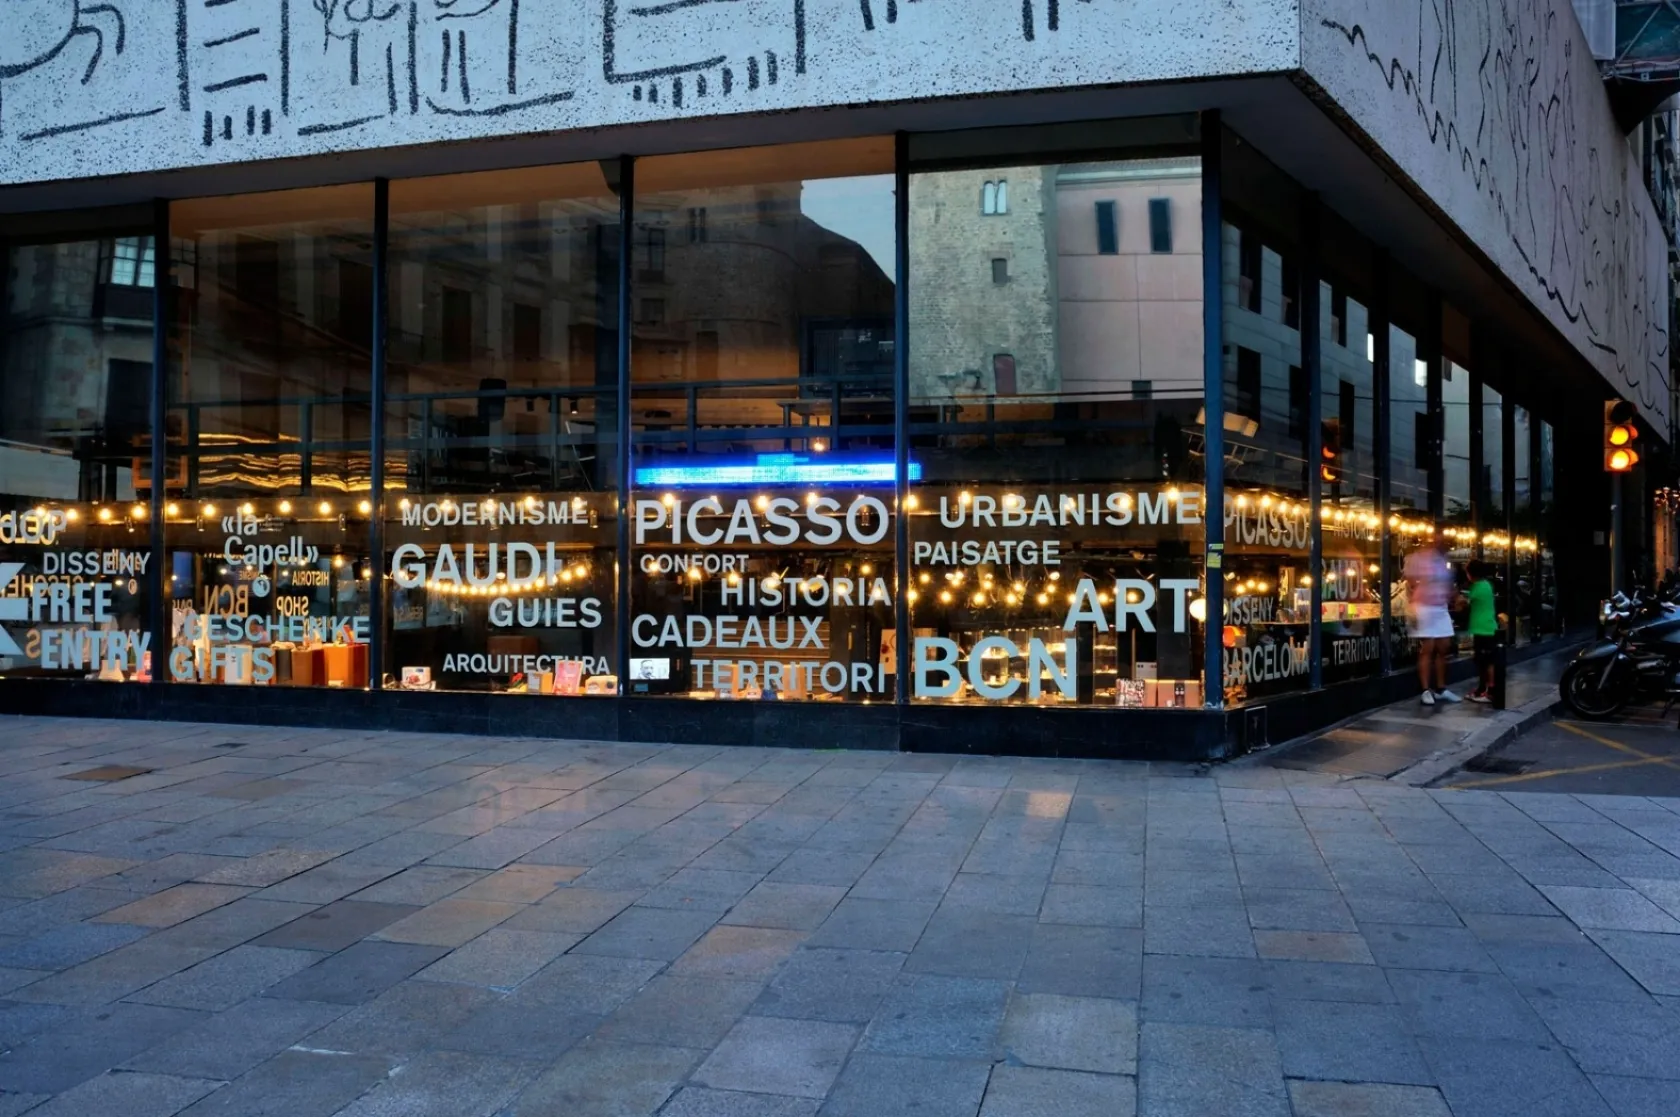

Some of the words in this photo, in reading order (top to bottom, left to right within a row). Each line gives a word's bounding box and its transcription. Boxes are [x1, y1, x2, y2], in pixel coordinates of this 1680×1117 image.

[401, 500, 588, 526] MODERNISME
[635, 497, 889, 545] PICASSO
[940, 492, 1201, 527] URBANISME
[43, 551, 151, 575] DISSENY
[391, 541, 556, 589] GAUDI
[640, 554, 749, 574] CONFORT
[914, 540, 1061, 565] PAISATGE
[32, 582, 112, 622] FREE
[721, 577, 891, 607] HISTORIA
[1063, 578, 1200, 633] ART
[183, 613, 370, 643] GESCHENKE
[489, 597, 602, 628] GUIES
[631, 614, 824, 649] CADEAUX
[40, 629, 151, 671] ENTRY
[168, 646, 275, 681] GIFTS
[442, 653, 611, 675] ARQUITECTURA
[690, 659, 885, 693] TERRITORI
[914, 636, 1077, 700] BCN
